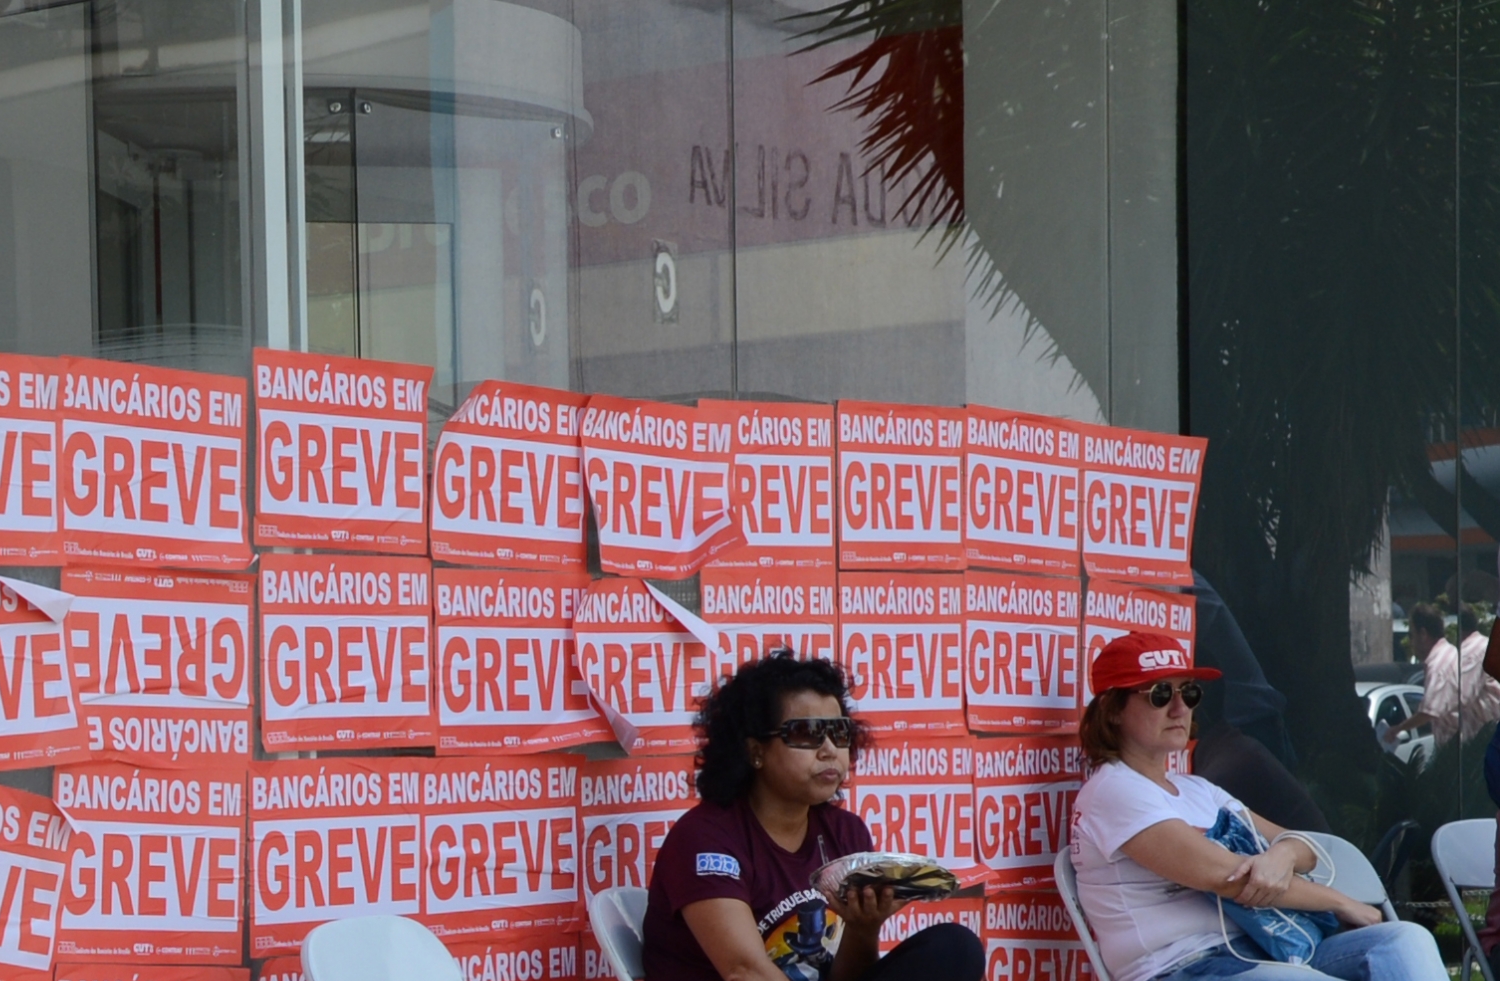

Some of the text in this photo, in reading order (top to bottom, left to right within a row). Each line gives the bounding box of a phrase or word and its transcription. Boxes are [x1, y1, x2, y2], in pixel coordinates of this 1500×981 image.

[22, 373, 59, 411] EM
[64, 372, 242, 428] BANCÁRIOS EM
[257, 362, 425, 413] BANCÁRIOS EM
[583, 407, 732, 453] BANCÁRIOS EM
[738, 411, 831, 448] CÁRIOS EM
[840, 409, 962, 448] BANCÁRIOS EM
[967, 417, 1079, 459] BANCÁRIOS EM
[263, 420, 421, 509] GREVE
[1084, 435, 1201, 475] BANCÁRIOS EM
[64, 430, 239, 529] GREVE
[436, 443, 583, 530] GREVE
[587, 457, 726, 541] GREVE
[735, 463, 830, 534] REVE
[844, 461, 959, 531] GREVE
[969, 463, 1077, 540] GREVE
[1087, 479, 1190, 551] GREVE
[263, 557, 428, 606] BANCÁRIOS EM
[438, 572, 555, 619] BANCÁRIOS
[704, 579, 834, 615] BANCÁRIOS EM
[841, 580, 962, 616] BANCÁRIOS EM
[966, 581, 1078, 619] BANCÁRIOS EM
[1086, 589, 1192, 632] BANCÁRIOS EM
[71, 611, 246, 700] GREVE
[267, 624, 428, 708] GREVE
[442, 636, 589, 714] GREVE
[580, 641, 709, 713] GREVE
[846, 631, 960, 701] GREVE
[969, 628, 1077, 698] GREVE
[1139, 650, 1179, 669] CUT
[109, 717, 248, 761] BANCÁRIOS
[856, 741, 973, 777] BANCÁRIOS EM
[975, 743, 1060, 779] BANCÁRIOS
[1167, 749, 1187, 775] EM
[58, 770, 242, 816] BANCÁRIOS EM
[252, 765, 419, 810] BANCÁRIOS EM
[424, 759, 577, 806] BANCÁRIOS EM
[581, 764, 689, 806] BANCÁRIOS
[27, 811, 71, 852] EM
[858, 792, 973, 858] GREVE
[64, 832, 237, 918] GREVE
[256, 824, 417, 912] GREVE
[429, 817, 574, 901] GREVE
[548, 946, 577, 978] EM
